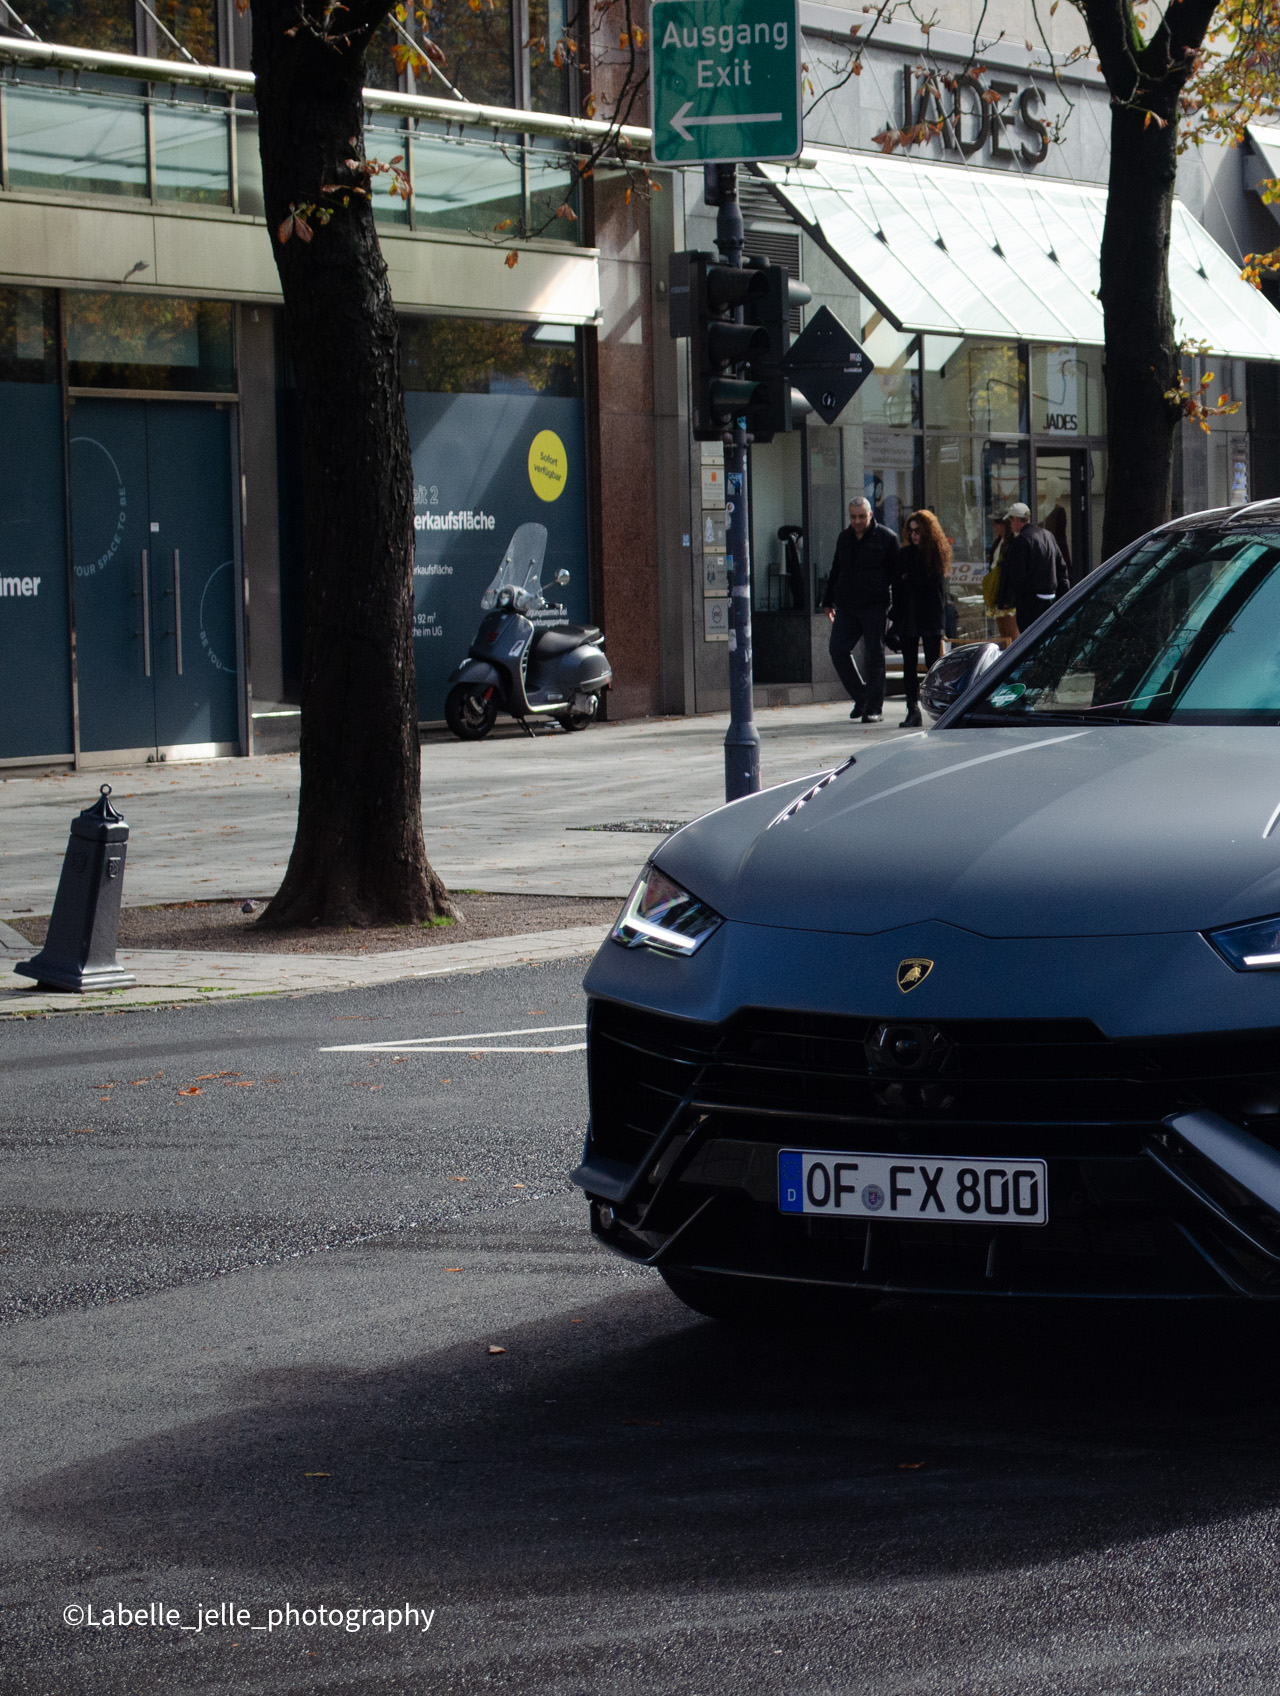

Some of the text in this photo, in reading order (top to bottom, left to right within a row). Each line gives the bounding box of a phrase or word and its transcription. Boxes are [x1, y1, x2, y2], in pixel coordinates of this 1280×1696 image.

[662, 21, 788, 53] Ausgang
[698, 58, 752, 88] Exit
[884, 64, 1048, 164] JADES
[1043, 413, 1077, 430] JADES
[540, 451, 558, 467] Sofort
[534, 463, 562, 481] verfügbar
[119, 487, 127, 506] BE
[430, 485, 439, 504] 2
[117, 511, 126, 531] TO
[414, 511, 495, 530] erkaufsfläche
[98, 533, 122, 570] SPACE
[417, 613, 426, 625] 92
[423, 626, 431, 637] im
[432, 625, 443, 637] UG
[200, 630, 223, 669] BE YOU
[787, 1161, 1039, 1216] D OF FX 800
